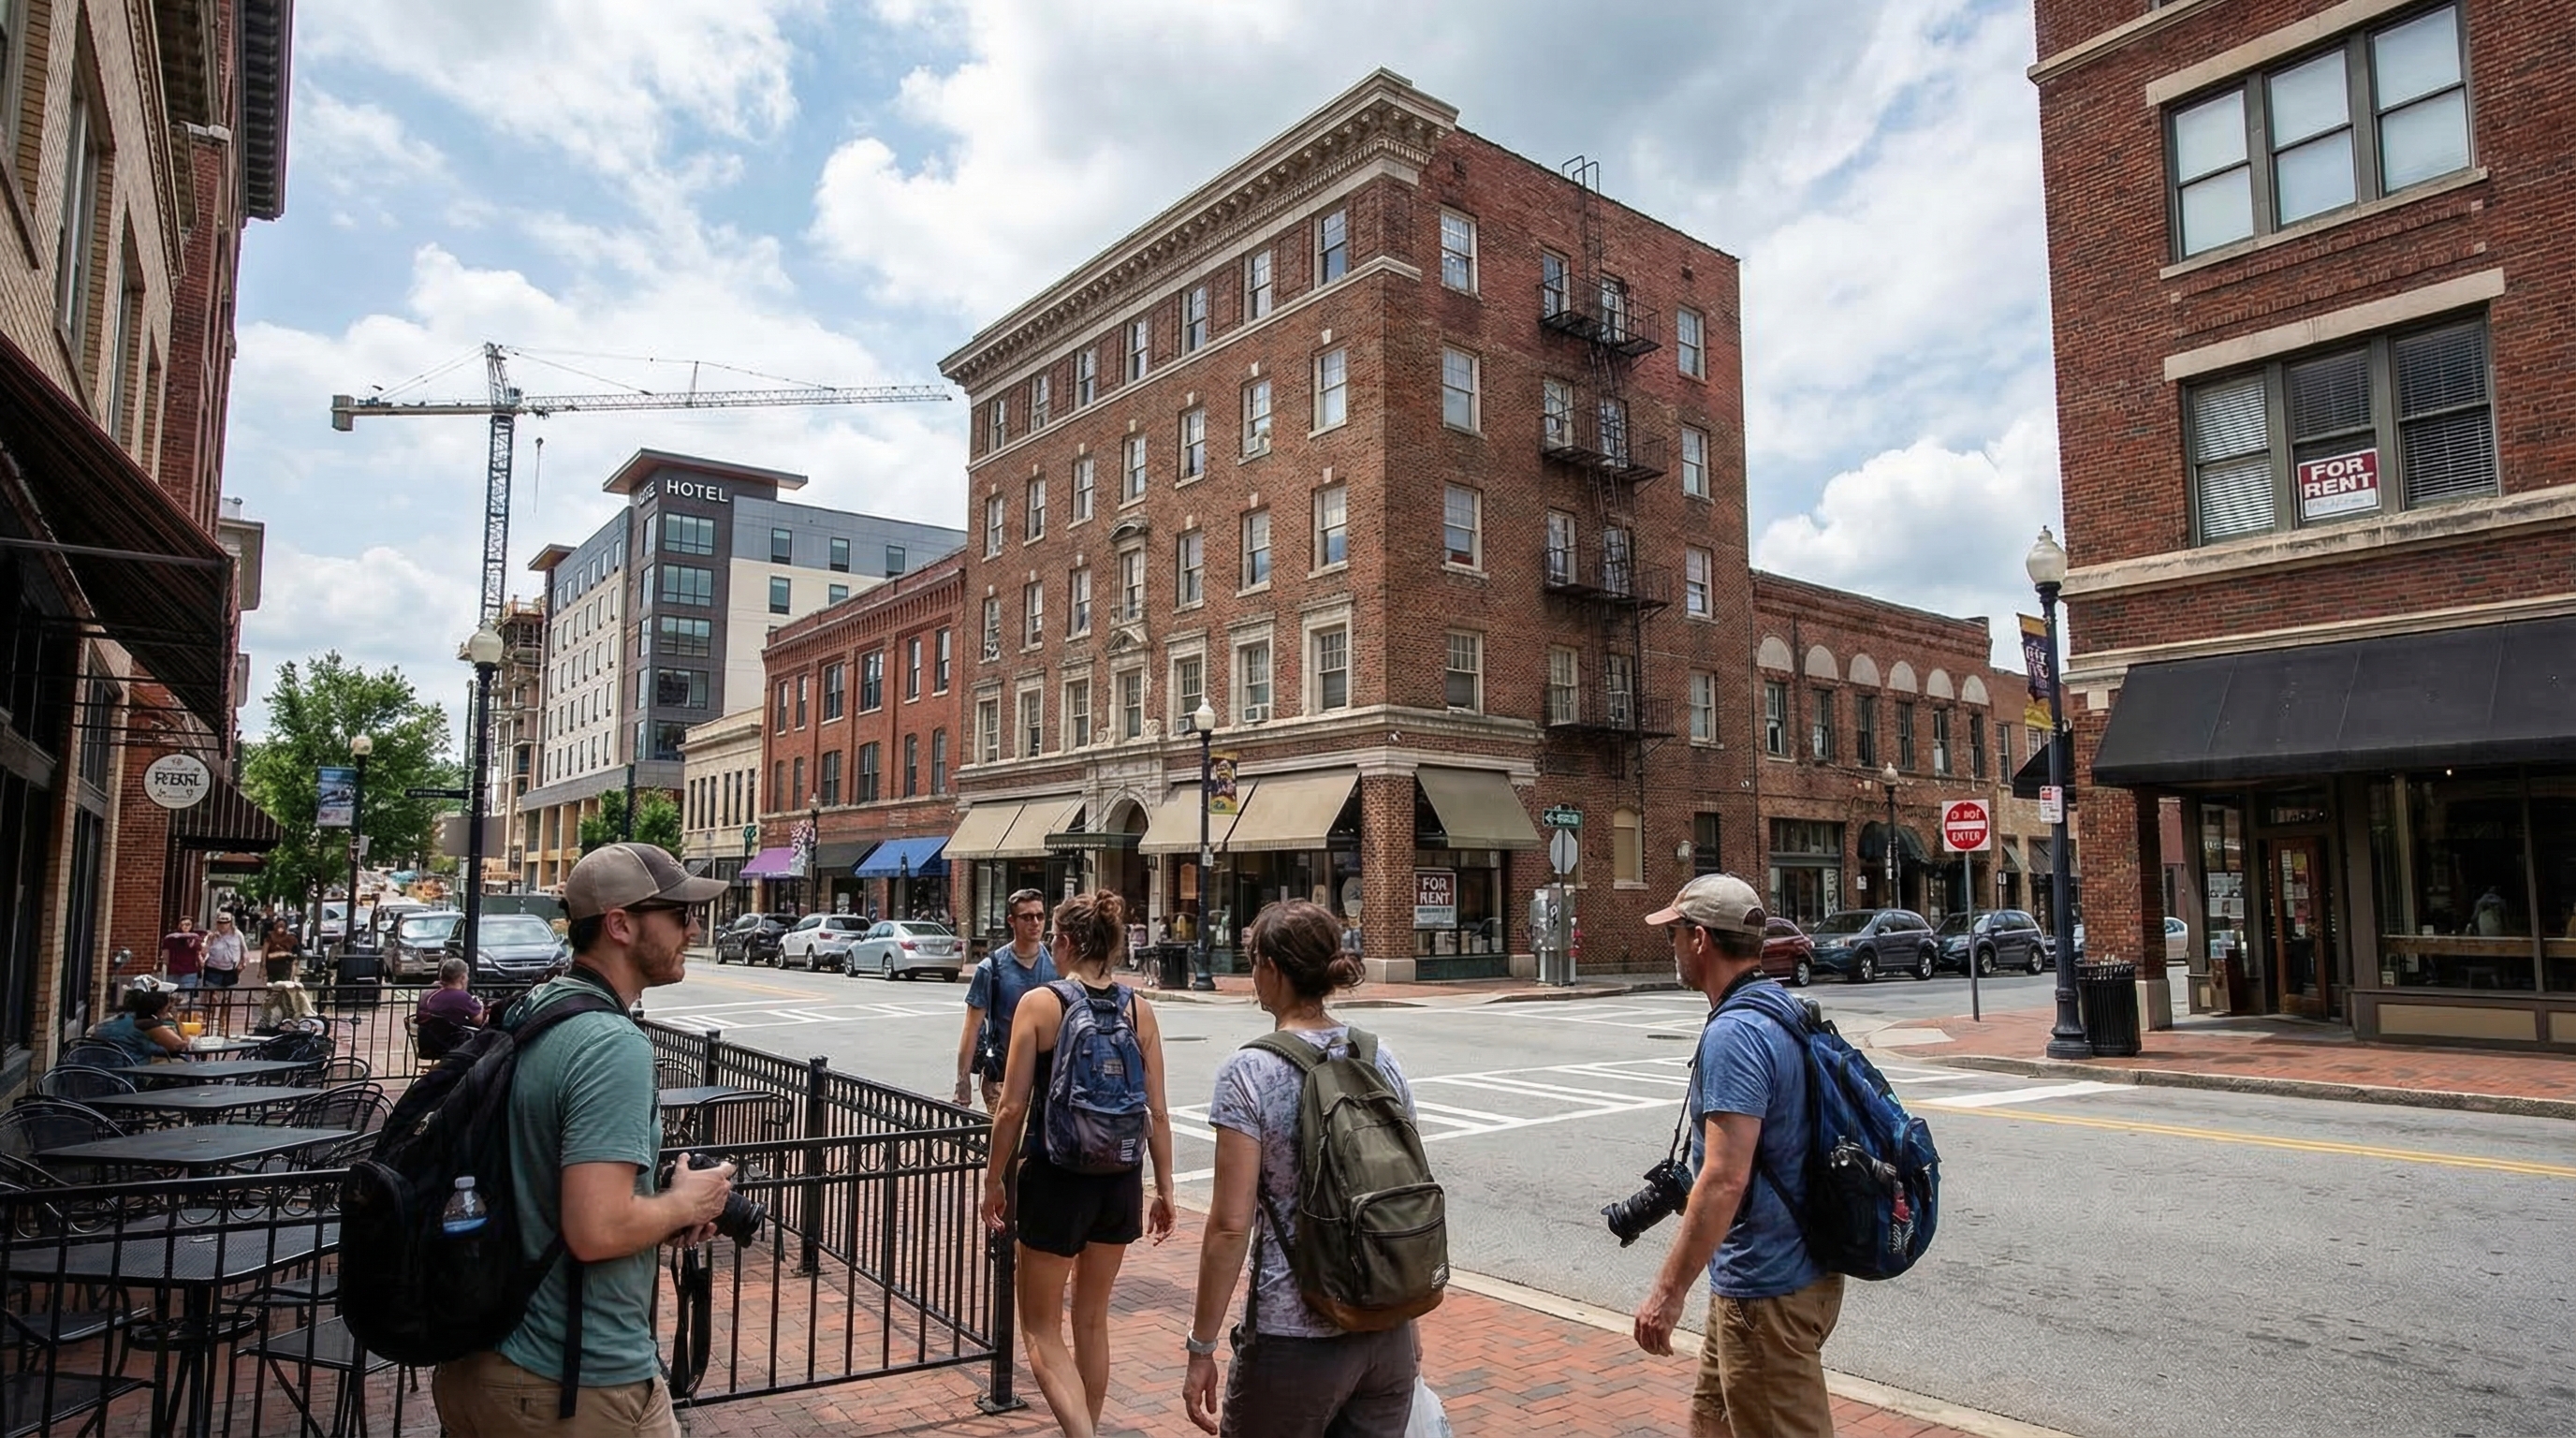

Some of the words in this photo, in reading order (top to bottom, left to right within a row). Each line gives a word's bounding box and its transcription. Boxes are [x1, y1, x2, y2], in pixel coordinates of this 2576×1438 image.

[2310, 457, 2364, 481] FOR
[666, 478, 729, 503] HOTEL
[2304, 471, 2375, 499] RENT
[1422, 876, 1447, 891] FOR
[1419, 891, 1451, 905] RENT
